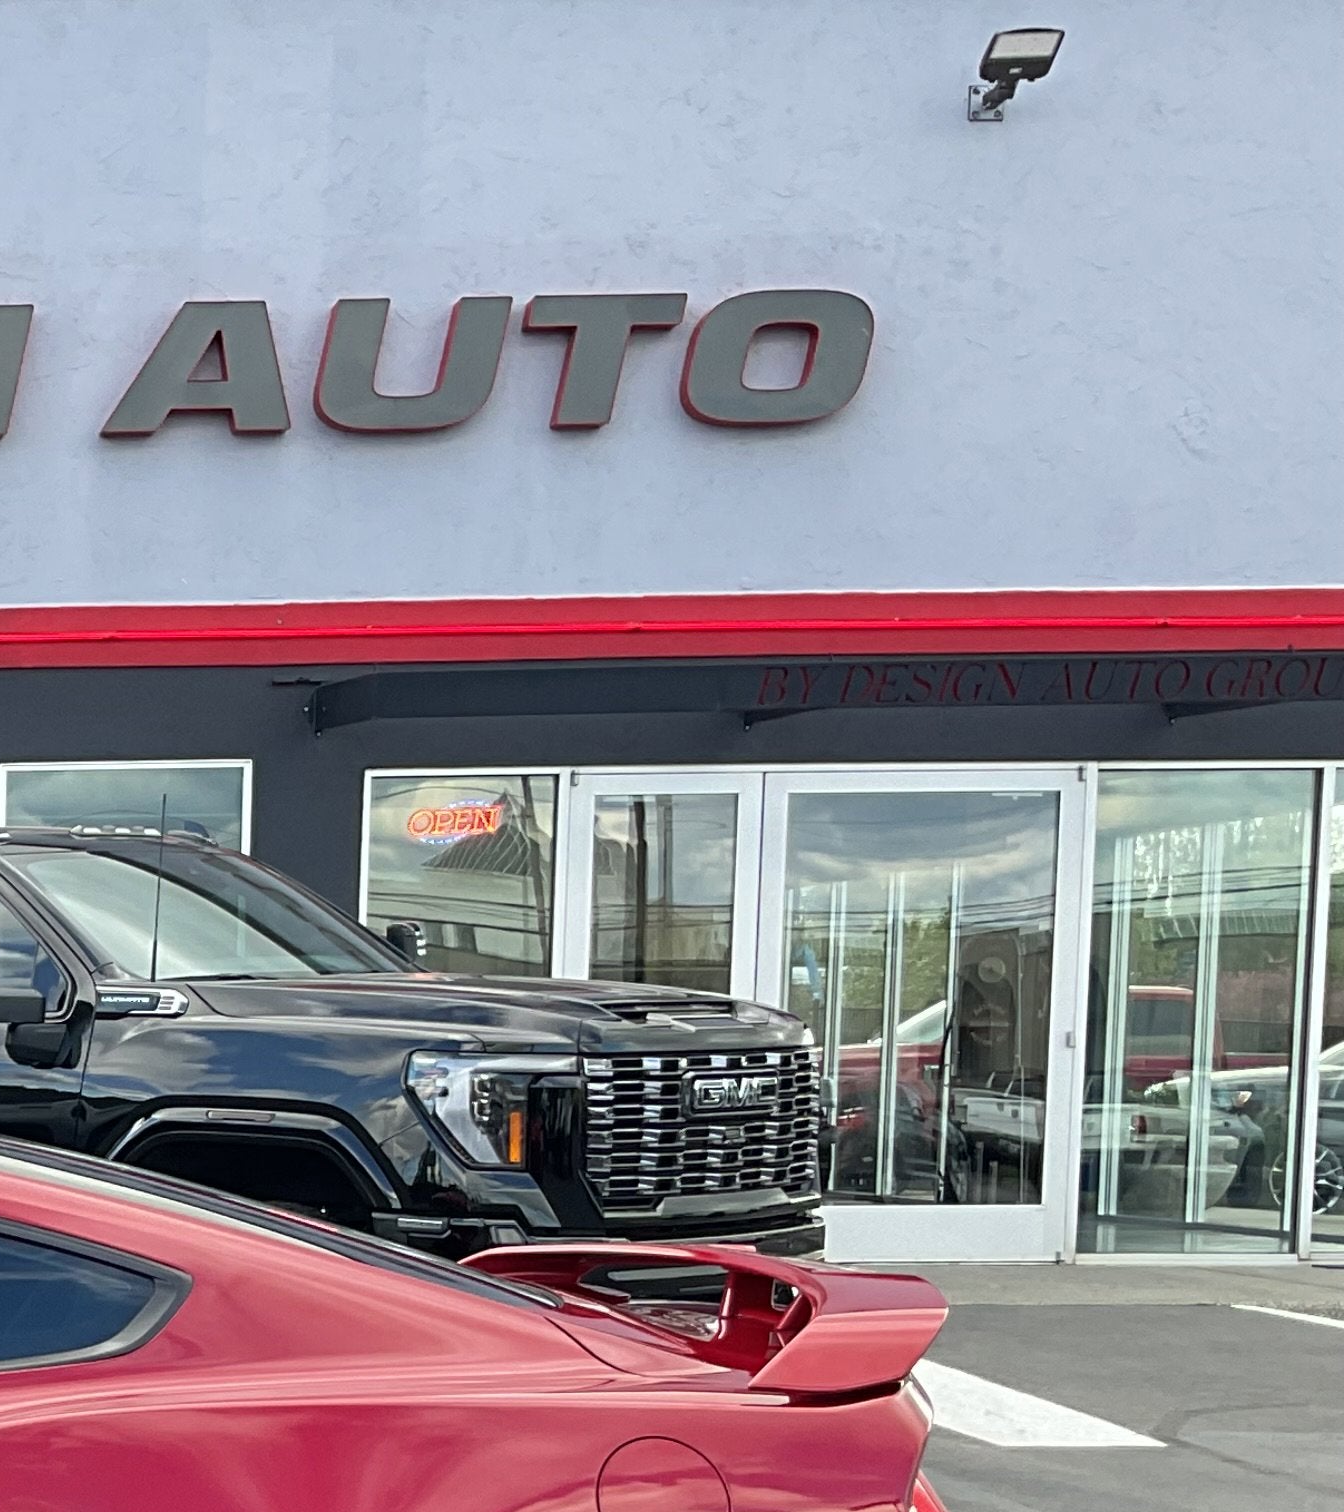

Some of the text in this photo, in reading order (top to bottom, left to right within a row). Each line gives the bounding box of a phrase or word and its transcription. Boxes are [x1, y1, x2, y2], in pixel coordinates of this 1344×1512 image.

[100, 289, 876, 438] AUTO
[757, 664, 830, 706] BY
[839, 661, 1027, 704] DESIGN
[1040, 658, 1191, 701] AUTO
[408, 806, 502, 837] OPEN
[693, 1077, 778, 1110] GMC
